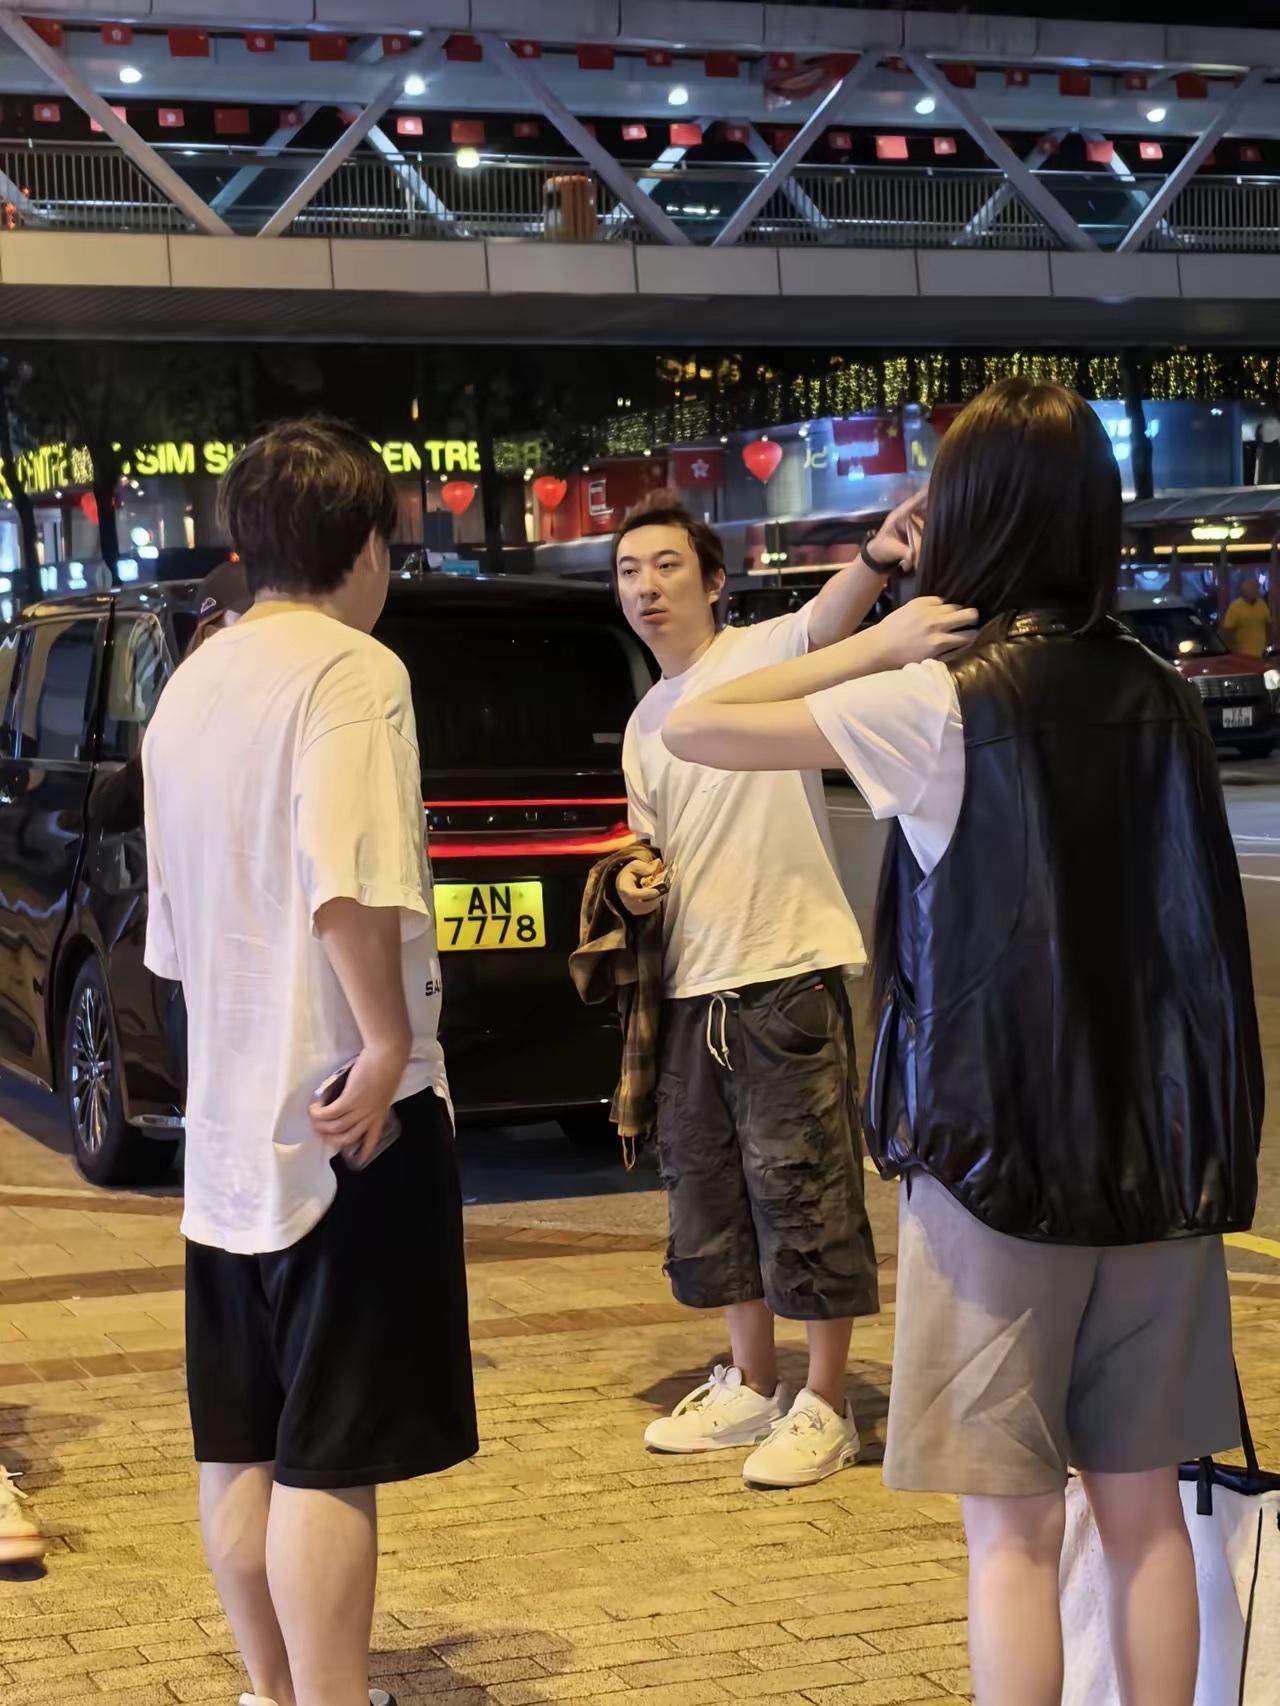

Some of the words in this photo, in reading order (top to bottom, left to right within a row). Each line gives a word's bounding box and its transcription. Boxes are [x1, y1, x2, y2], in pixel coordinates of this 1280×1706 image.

[111, 440, 196, 476] SIM
[369, 439, 482, 473] ENTRE
[467, 885, 512, 915] AN
[443, 914, 537, 946] 7778
